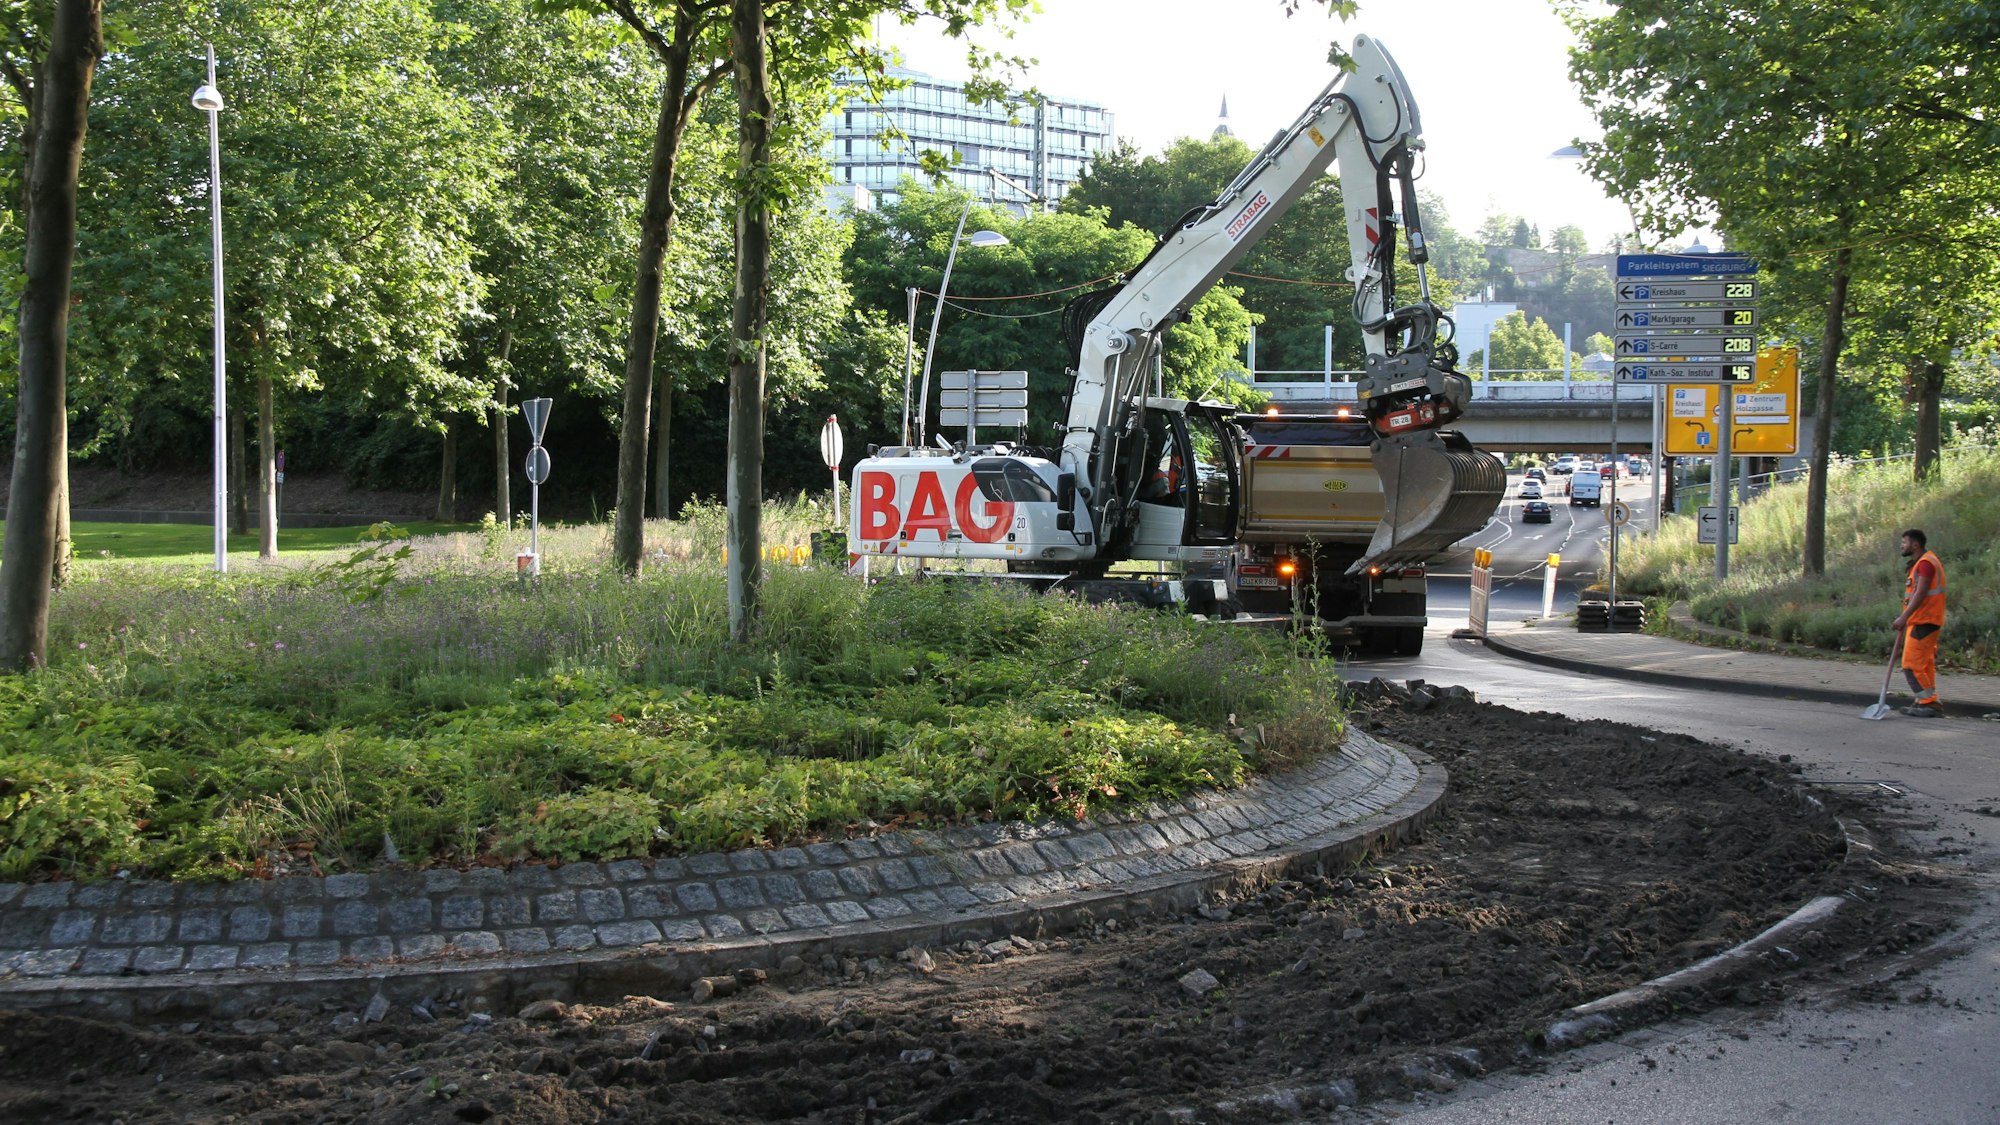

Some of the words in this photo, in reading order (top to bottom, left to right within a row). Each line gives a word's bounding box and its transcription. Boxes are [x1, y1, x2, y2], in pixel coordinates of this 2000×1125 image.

[1227, 194, 1268, 238] STRABAG
[1628, 261, 1700, 271] Parkleitsystem
[1701, 263, 1747, 273] SIEGBURG
[1651, 288, 1686, 296] Kreishaus
[1726, 284, 1753, 298] 228
[1650, 314, 1696, 325] Marktgarage
[1733, 311, 1752, 325] 20
[1724, 338, 1752, 352] 208
[1649, 368, 1685, 377] Kath.-Soz.
[1687, 368, 1714, 377] Institut
[1732, 366, 1750, 380] 46
[1391, 418, 1400, 426] TR
[860, 471, 1015, 543] BAG
[1016, 517, 1026, 529] 20
